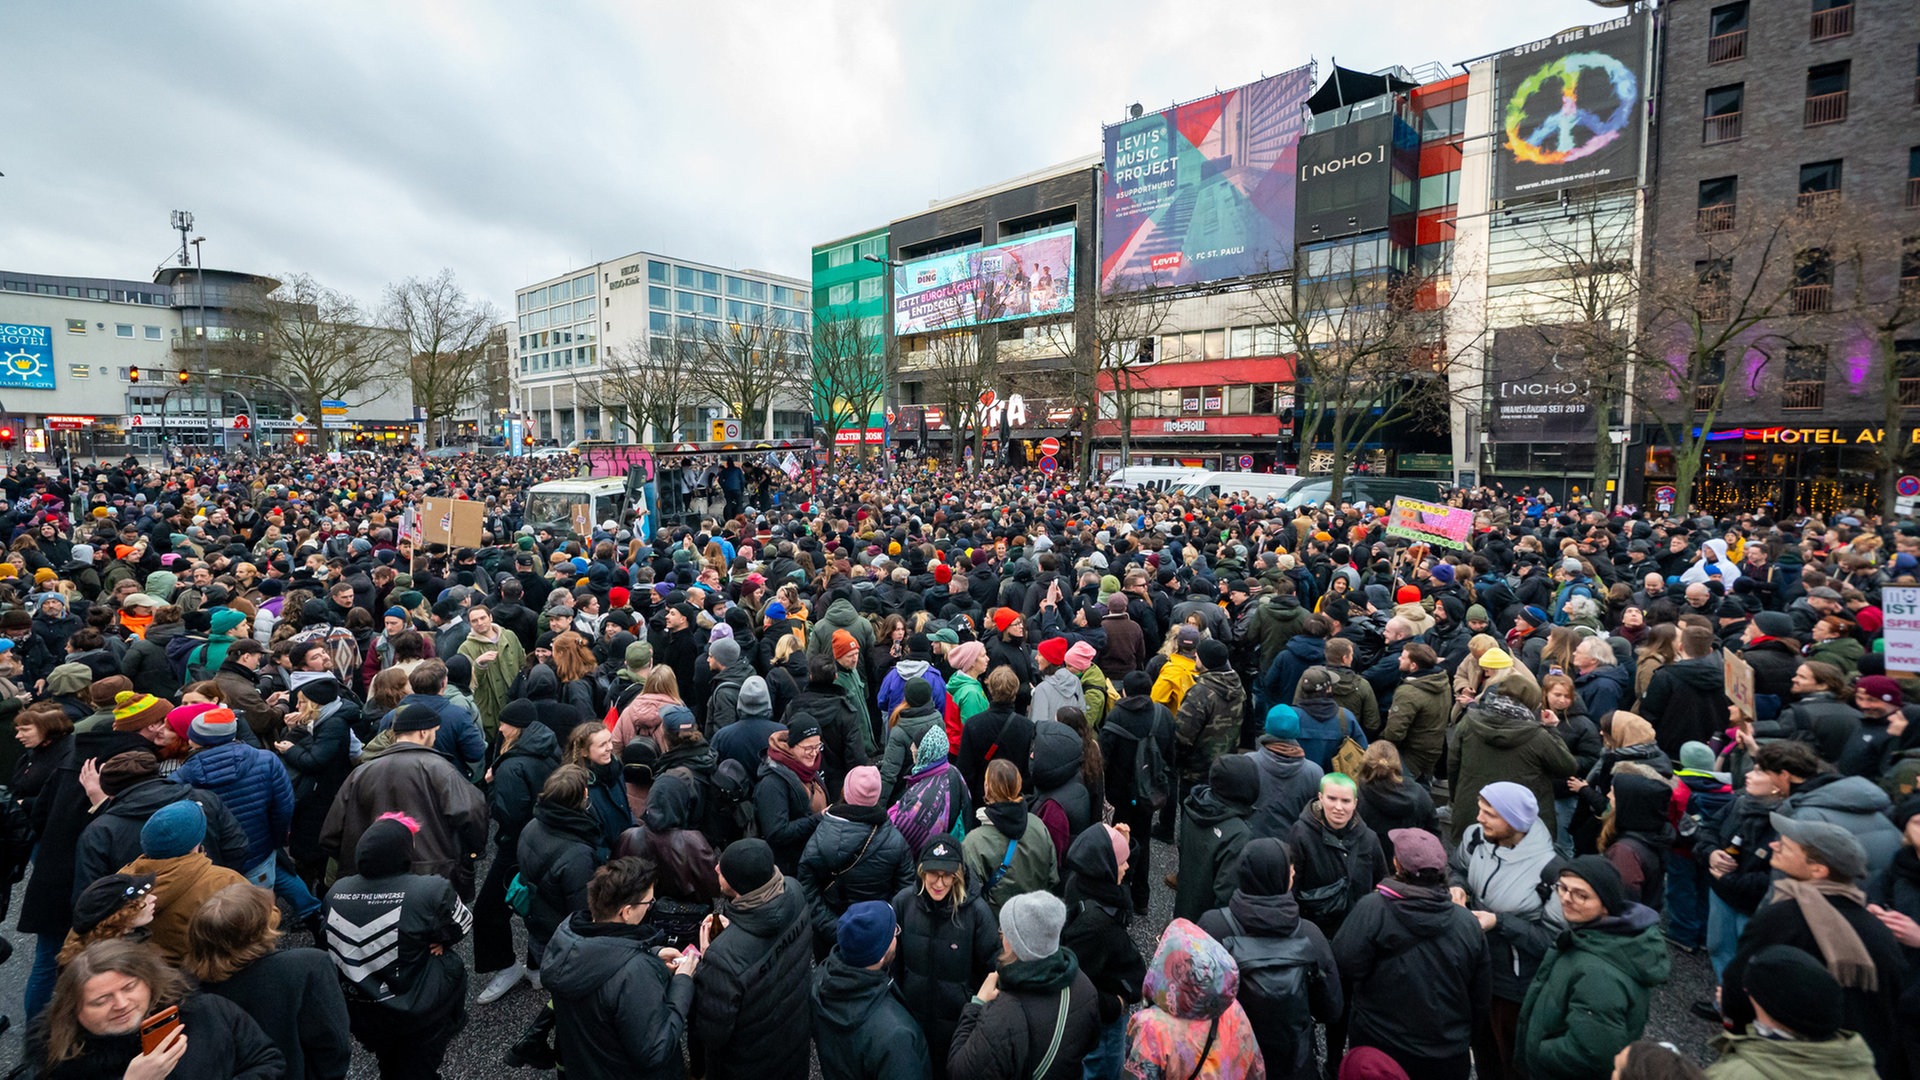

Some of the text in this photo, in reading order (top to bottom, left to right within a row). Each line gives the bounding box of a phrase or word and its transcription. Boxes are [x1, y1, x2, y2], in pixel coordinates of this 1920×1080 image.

[1514, 15, 1632, 57] STOP THE WAR!
[1116, 146, 1159, 168] MUSIC
[1312, 151, 1373, 177] NOHO
[1116, 156, 1179, 184] PROJECT
[1116, 179, 1175, 199] #SUPPORTMUSIC
[1196, 252, 1206, 260] FC
[1207, 250, 1219, 258] ST.
[1220, 245, 1245, 256] PAULI
[917, 273, 937, 284] DING
[898, 295, 920, 309] JETZT
[1512, 382, 1577, 395] NOHO
[1548, 404, 1565, 413] SEIT
[1565, 404, 1585, 413] 2013
[835, 432, 861, 440] OLSTEN
[1762, 428, 1848, 444] HOTEL
[1399, 499, 1449, 515] TOURISM
[1401, 520, 1449, 536] KILLING
[1886, 604, 1917, 614] IST
[775, 919, 806, 961] PAULI
